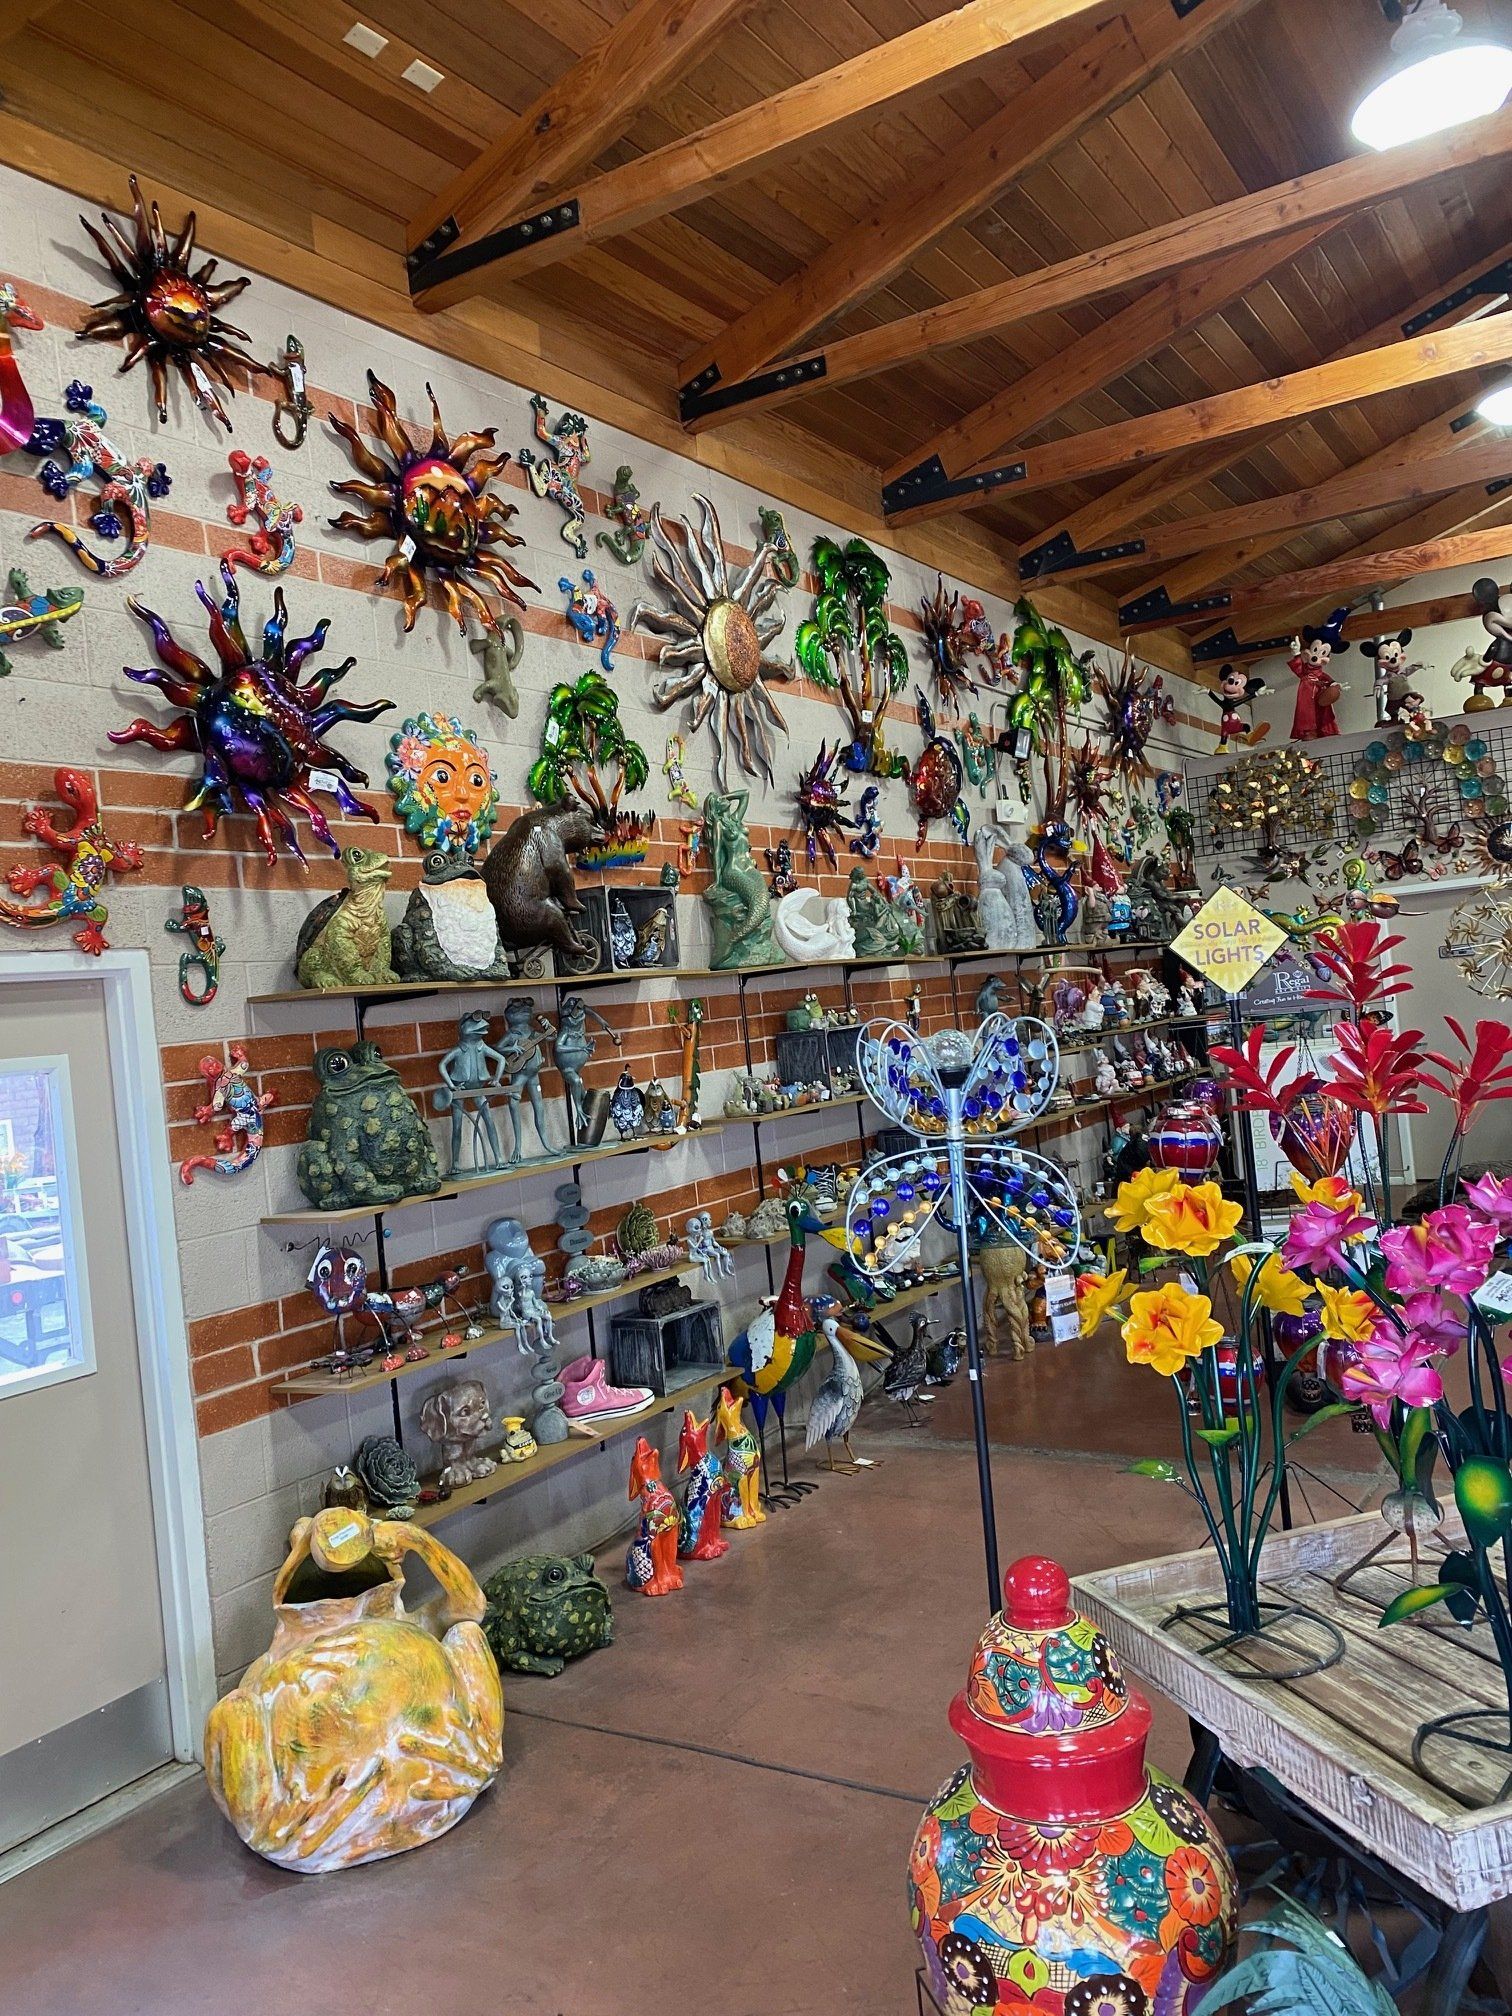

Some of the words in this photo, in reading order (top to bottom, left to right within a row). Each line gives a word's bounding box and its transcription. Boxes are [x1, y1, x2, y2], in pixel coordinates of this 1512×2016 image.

[1193, 919, 1261, 940] SOLAR
[1195, 945, 1264, 966] LIGHTS
[1272, 971, 1310, 991] Regal
